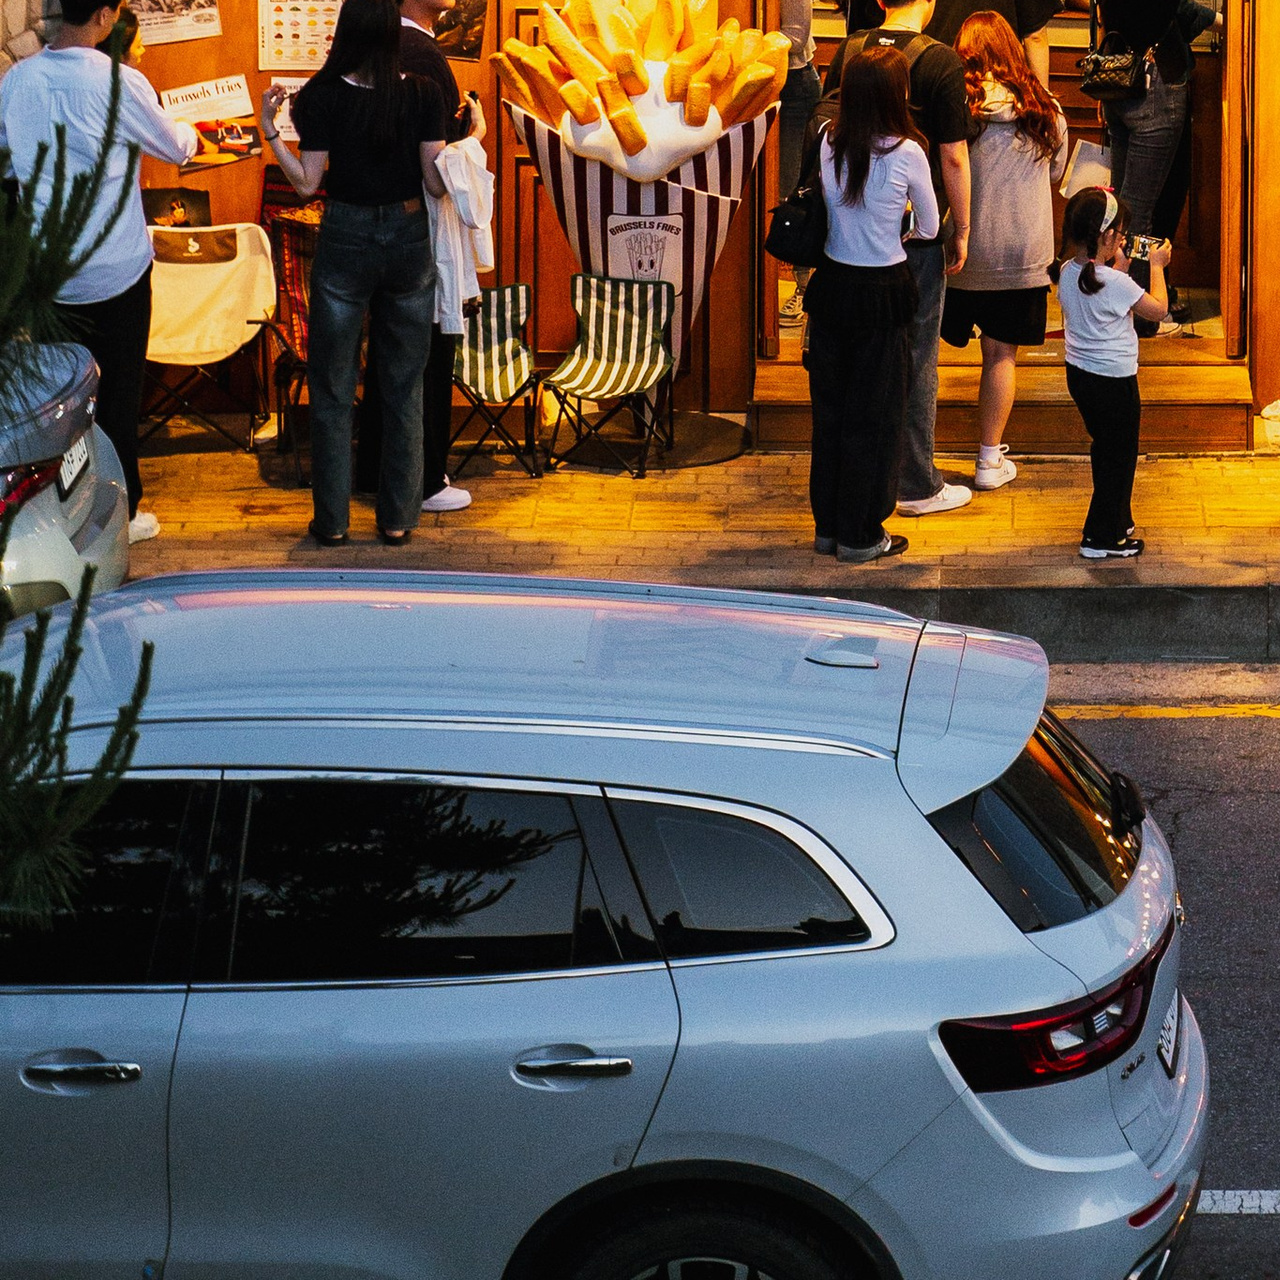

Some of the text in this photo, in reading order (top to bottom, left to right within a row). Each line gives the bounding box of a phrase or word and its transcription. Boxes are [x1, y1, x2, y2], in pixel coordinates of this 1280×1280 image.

[166, 79, 242, 107] brussels fries
[609, 221, 682, 236] BRUSSELS FRIES
